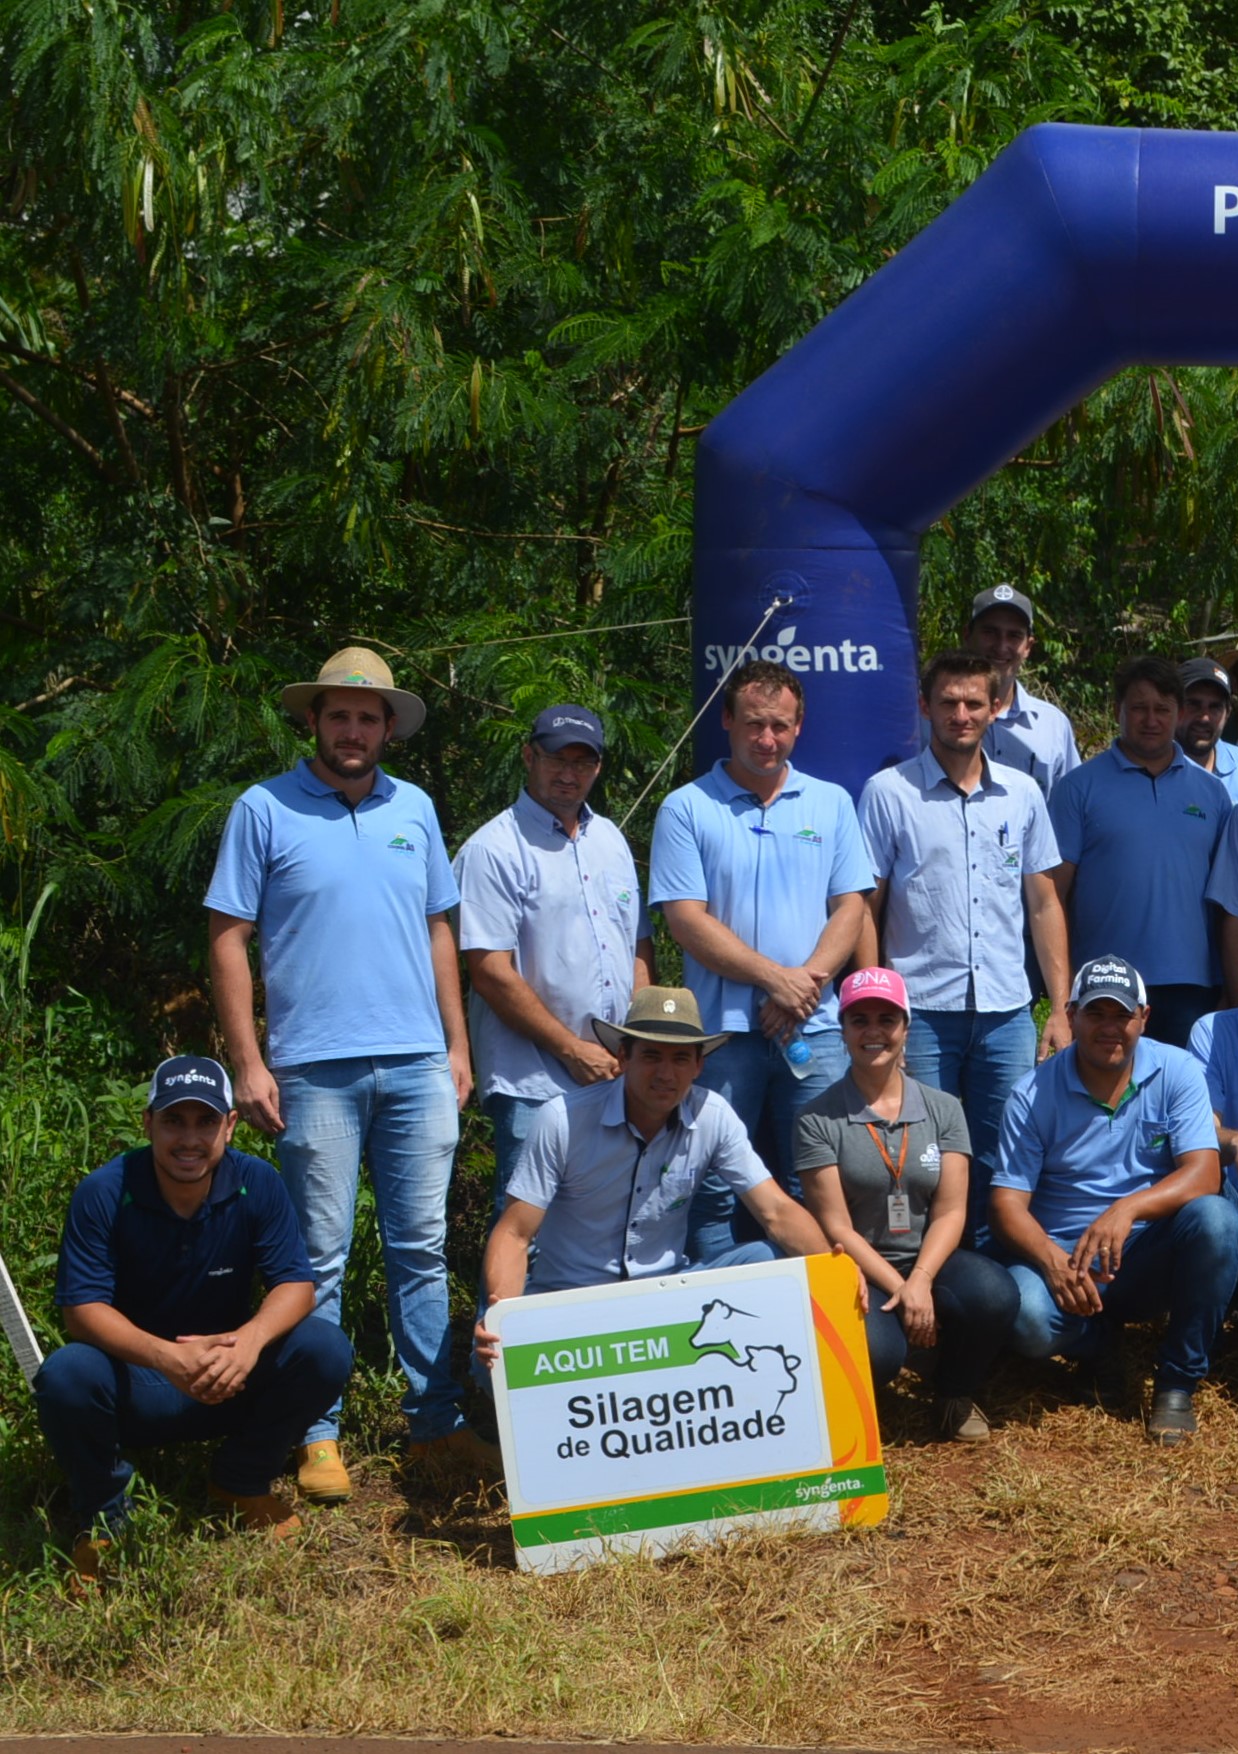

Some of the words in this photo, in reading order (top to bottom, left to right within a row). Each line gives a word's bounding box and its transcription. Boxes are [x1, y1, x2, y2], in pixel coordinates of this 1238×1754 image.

[1092, 961, 1127, 975] Digital
[1087, 974, 1131, 988] Farming
[164, 1071, 217, 1087] syngenta
[533, 1345, 603, 1376] AQUI
[610, 1336, 670, 1365] TEM
[567, 1383, 735, 1429] Silagem
[556, 1436, 590, 1459] de
[600, 1409, 786, 1459] Qualidade
[795, 1477, 861, 1501] syngenta
